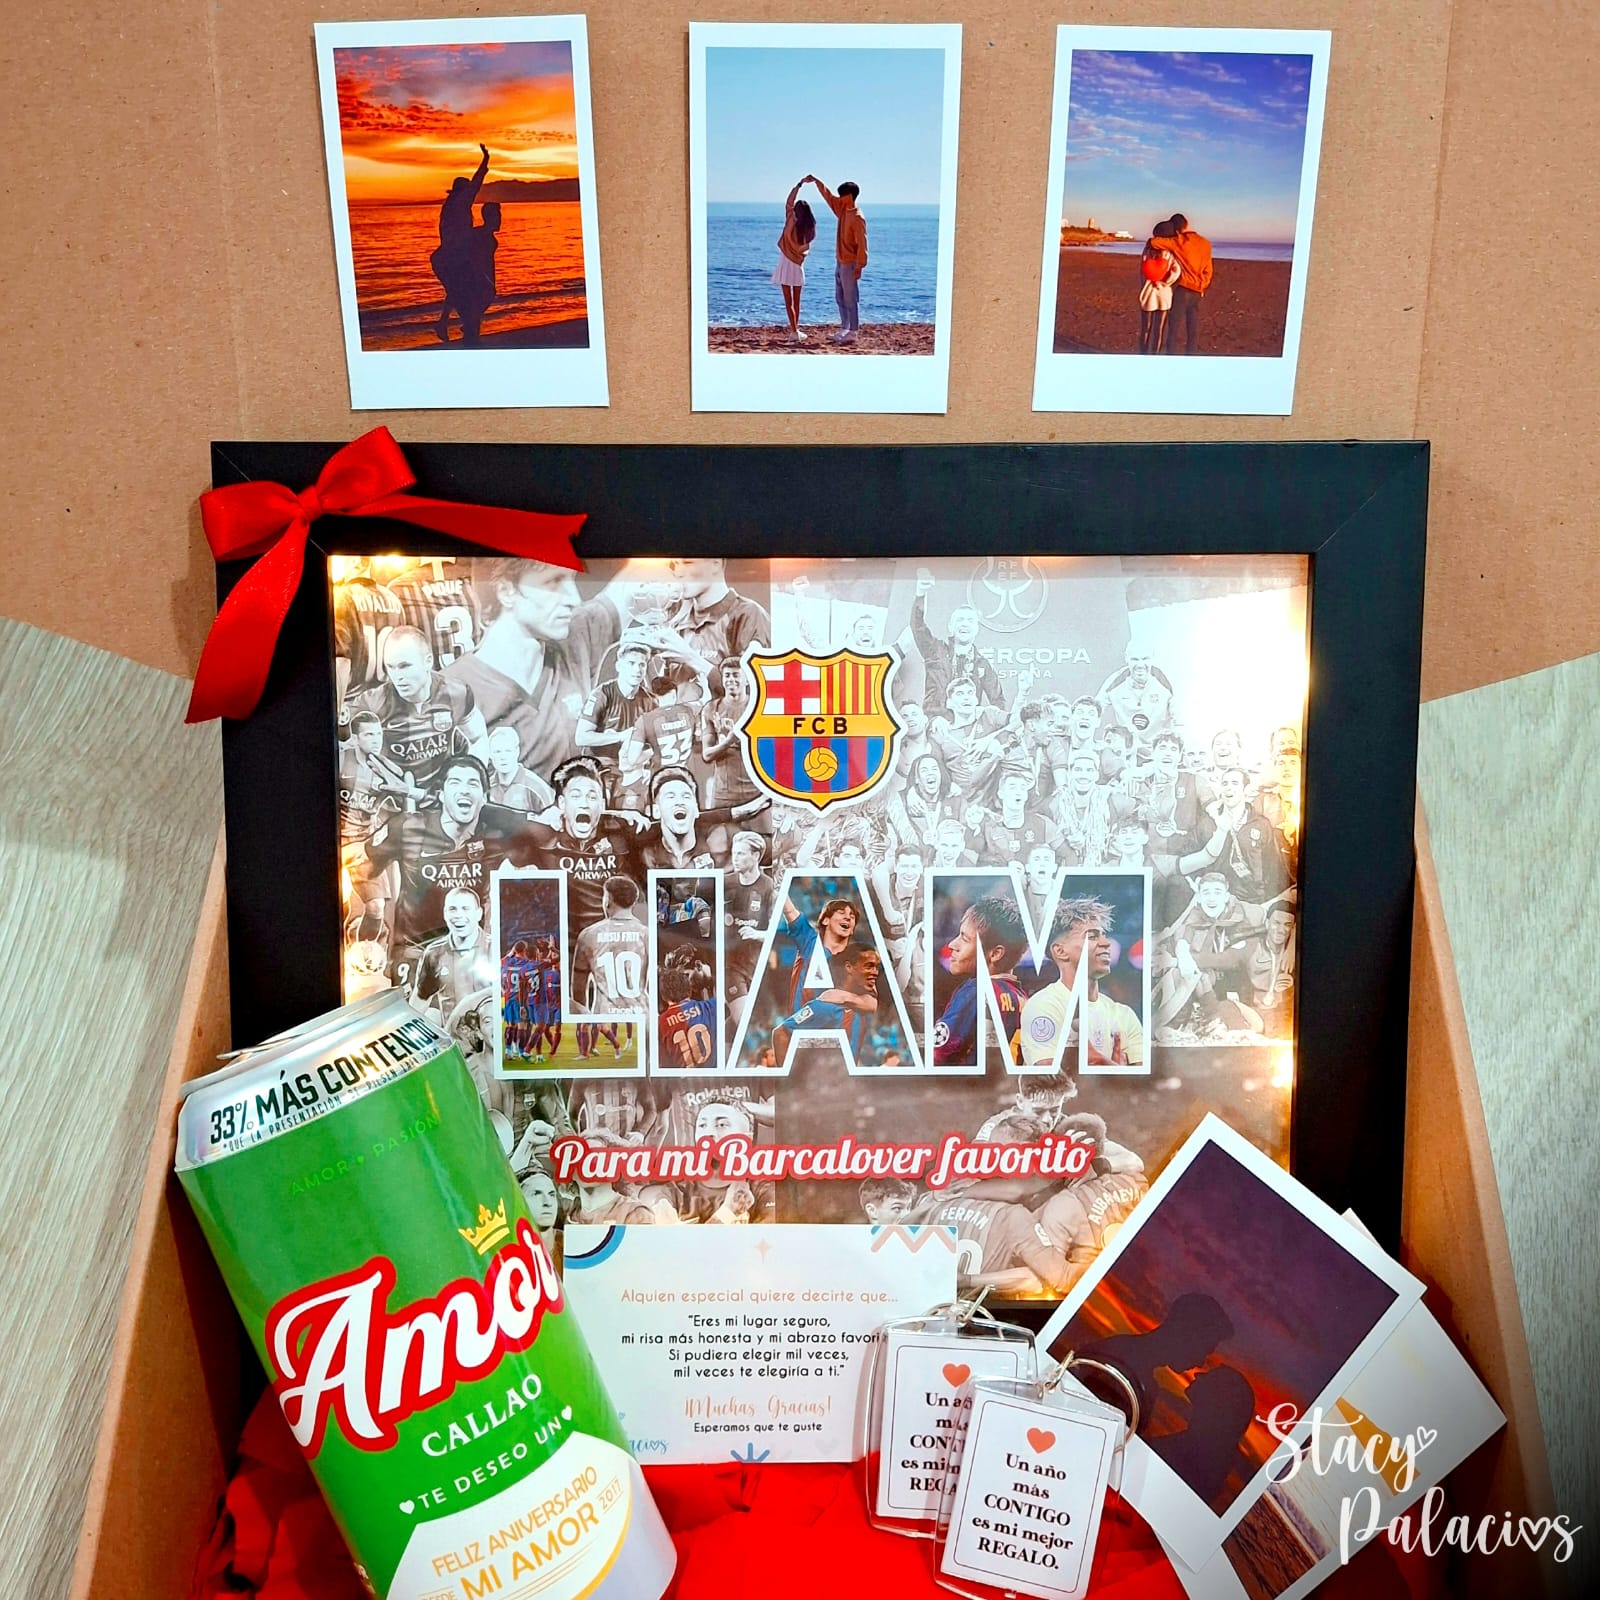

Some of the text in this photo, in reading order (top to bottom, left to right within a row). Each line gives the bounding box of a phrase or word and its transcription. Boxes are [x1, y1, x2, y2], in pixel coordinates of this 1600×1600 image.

[978, 647, 1092, 664] ERCOPA
[793, 716, 848, 735] FCB
[390, 733, 448, 757] QATAR
[421, 863, 483, 881] QATAR
[559, 855, 617, 873] QATAR
[490, 867, 1152, 1077] LIAM
[597, 951, 642, 999] 10
[666, 1006, 702, 1027] MESSI
[673, 1023, 712, 1068] 10
[210, 1017, 440, 1145] 33% MÁS CONTENIDO
[686, 1085, 751, 1107] Rakuten
[269, 1096, 342, 1135] PRESENTACIÓN
[553, 1136, 1091, 1187] Para mi Barcalover favorito
[291, 1159, 350, 1196] AMOR
[940, 1206, 990, 1230] FERRAN
[681, 1288, 744, 1305] especial
[749, 1289, 796, 1305] quiere
[801, 1288, 854, 1303] decirte
[860, 1291, 899, 1305] que...
[725, 1315, 739, 1327] mi
[743, 1314, 778, 1330] lugar
[783, 1317, 831, 1329] seguro,
[270, 1222, 562, 1452] Amor
[621, 1331, 882, 1346] mi risa más honesta y mi abrazo favori
[668, 1347, 849, 1363] Si pudiera elegir mil veces,
[673, 1365, 690, 1378] mil
[695, 1367, 735, 1378] veces
[740, 1366, 753, 1378] te
[757, 1364, 809, 1379] elegiría
[814, 1366, 823, 1378] a
[767, 1394, 833, 1420] Gracias!
[925, 1391, 949, 1407] Un
[421, 1373, 542, 1457] CALLAO
[694, 1422, 823, 1434] Esperamos que te guste
[417, 1415, 562, 1509] TE DESEO UN
[901, 1458, 919, 1470] es
[923, 1457, 946, 1471] mi
[1005, 1453, 1067, 1481] Un año
[1012, 1481, 1050, 1500] más
[431, 1541, 485, 1578] FELIZ
[487, 1465, 598, 1555] ANIVERSARIO
[984, 1493, 1072, 1527] CONTIGO
[972, 1516, 1074, 1552] es mi mejor
[460, 1501, 600, 1600] MI AMOR
[977, 1536, 1060, 1570] REGALO.
